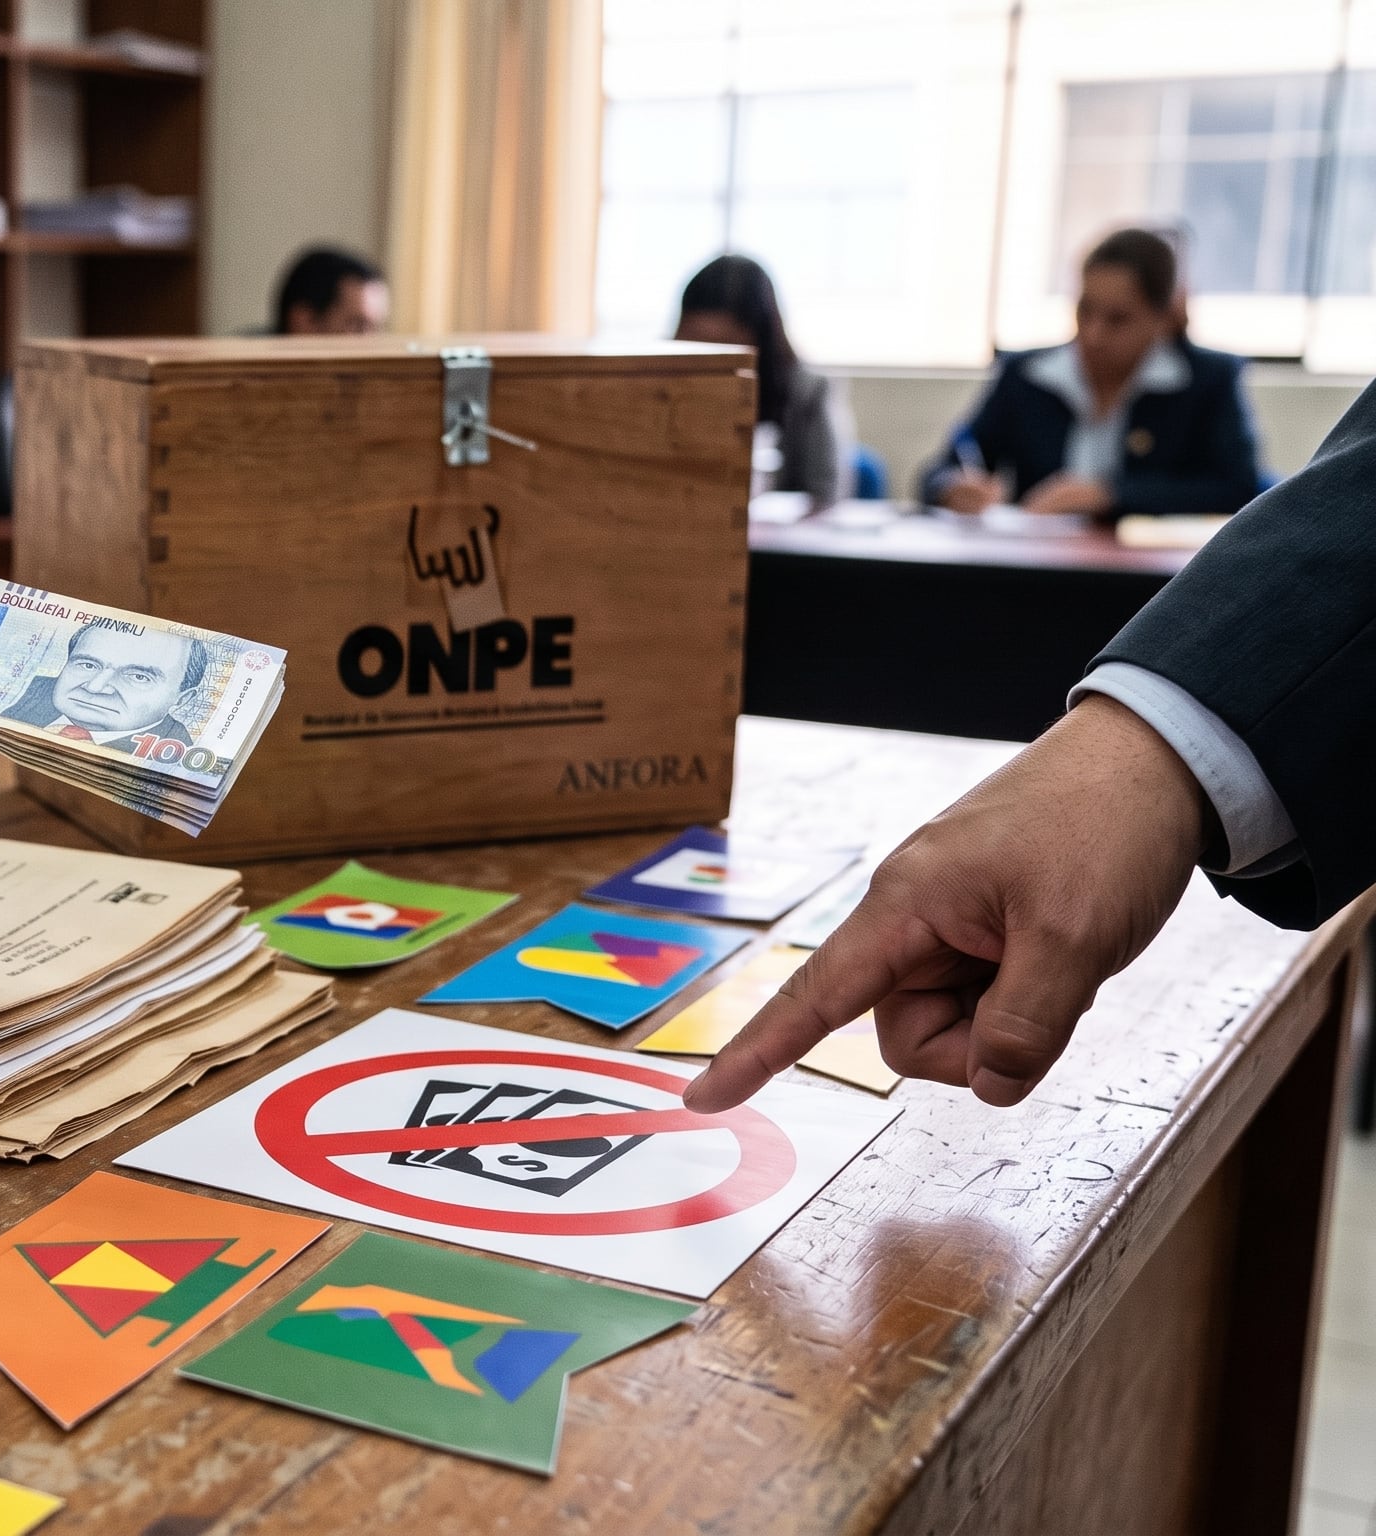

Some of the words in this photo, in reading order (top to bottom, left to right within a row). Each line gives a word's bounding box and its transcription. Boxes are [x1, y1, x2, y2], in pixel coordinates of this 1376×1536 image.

[337, 616, 575, 698] ONPE
[131, 733, 217, 772] 100
[556, 754, 709, 795] ANFORA
